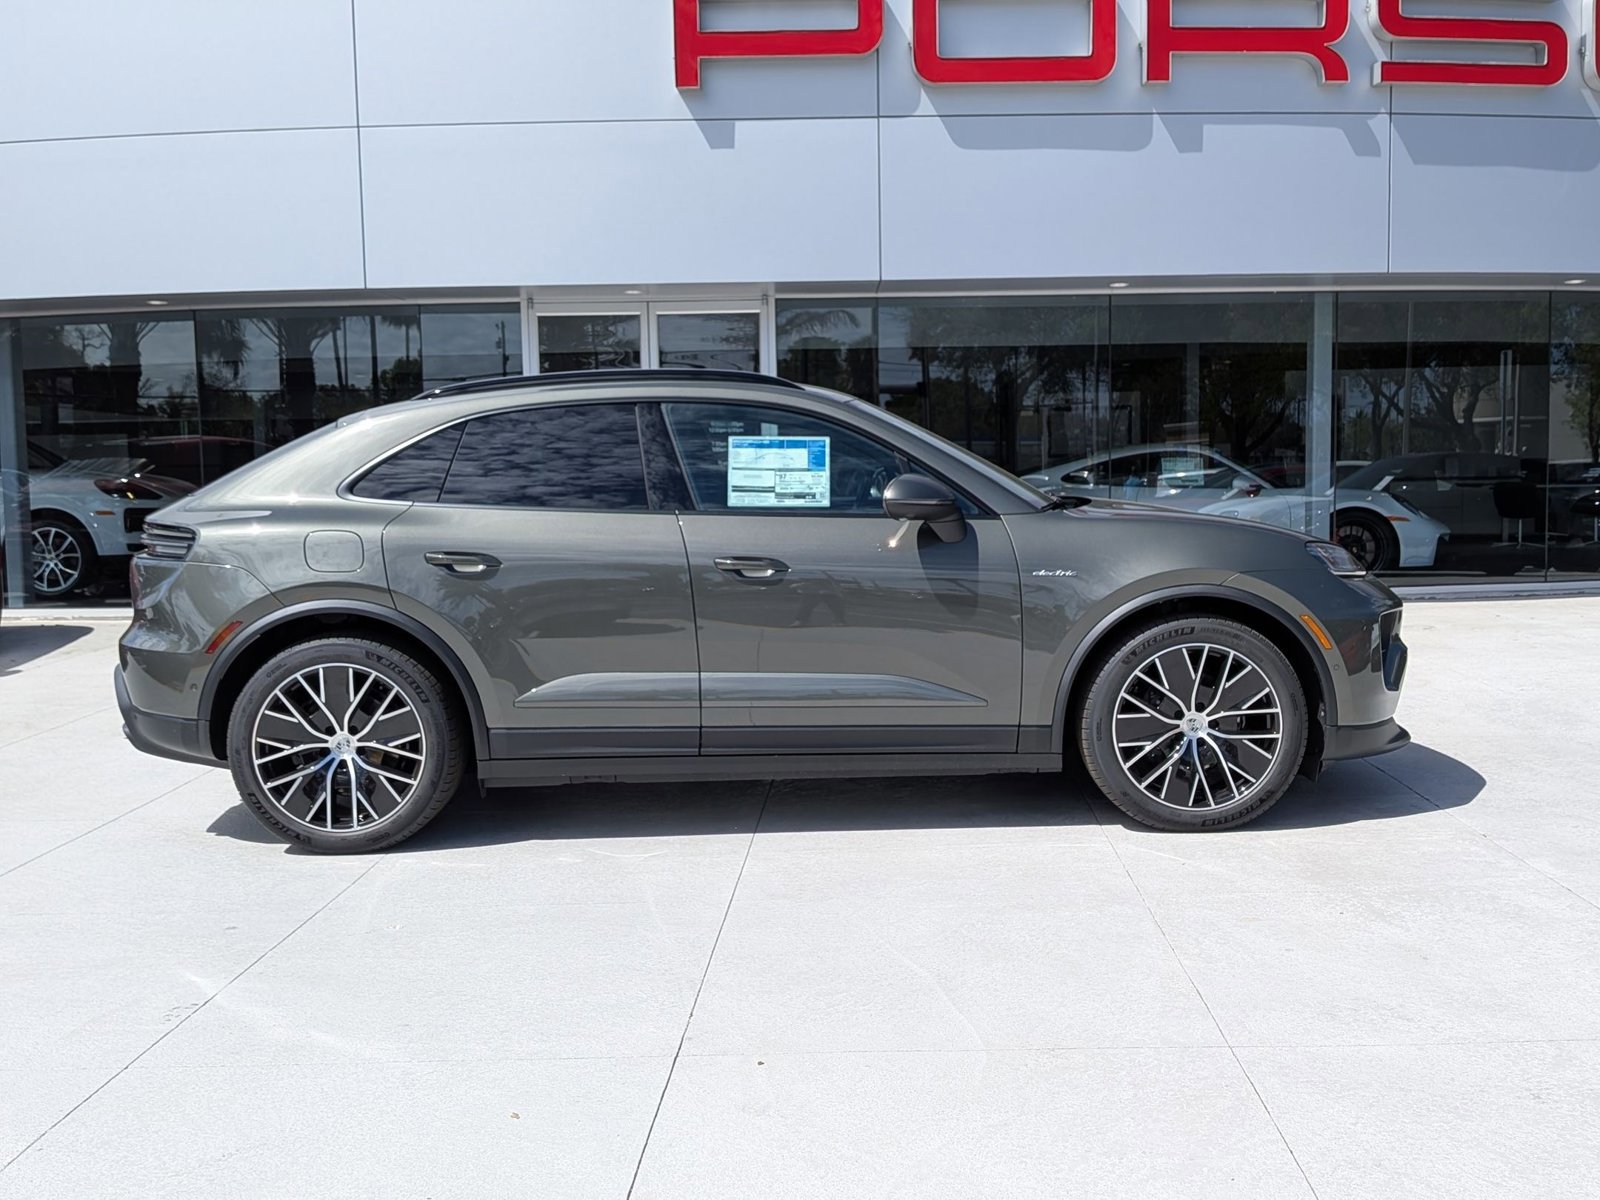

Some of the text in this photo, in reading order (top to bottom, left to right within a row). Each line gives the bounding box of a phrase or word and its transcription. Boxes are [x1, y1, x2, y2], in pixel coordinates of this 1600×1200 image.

[673, 0, 1600, 90] PORS
[1032, 569, 1078, 577] electric
[1135, 627, 1192, 655] MICHELIN
